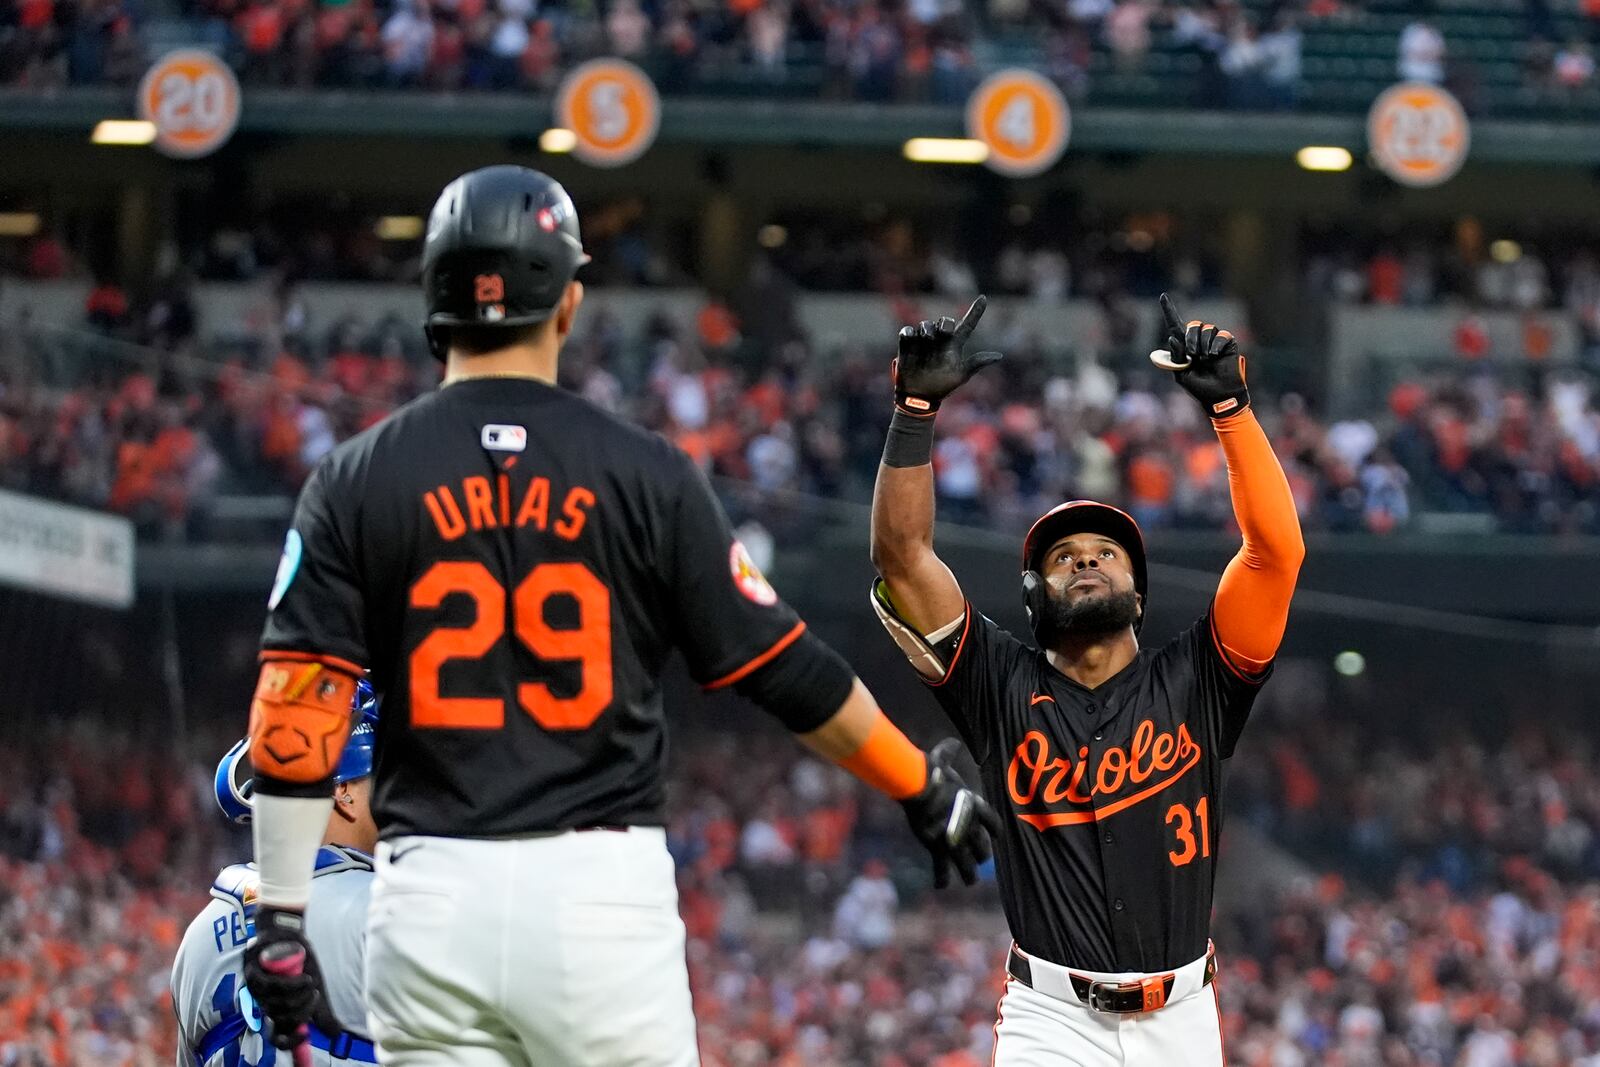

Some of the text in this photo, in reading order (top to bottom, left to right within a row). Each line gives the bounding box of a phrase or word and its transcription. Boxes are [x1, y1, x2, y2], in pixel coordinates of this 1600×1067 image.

[162, 74, 225, 130] 20
[589, 81, 630, 138] 5
[997, 94, 1035, 149] 4
[423, 455, 596, 542] URÍAS
[409, 561, 613, 729] 29
[1007, 719, 1201, 805] Orioles
[1165, 796, 1210, 867] 31
[1146, 988, 1162, 1009] 31
